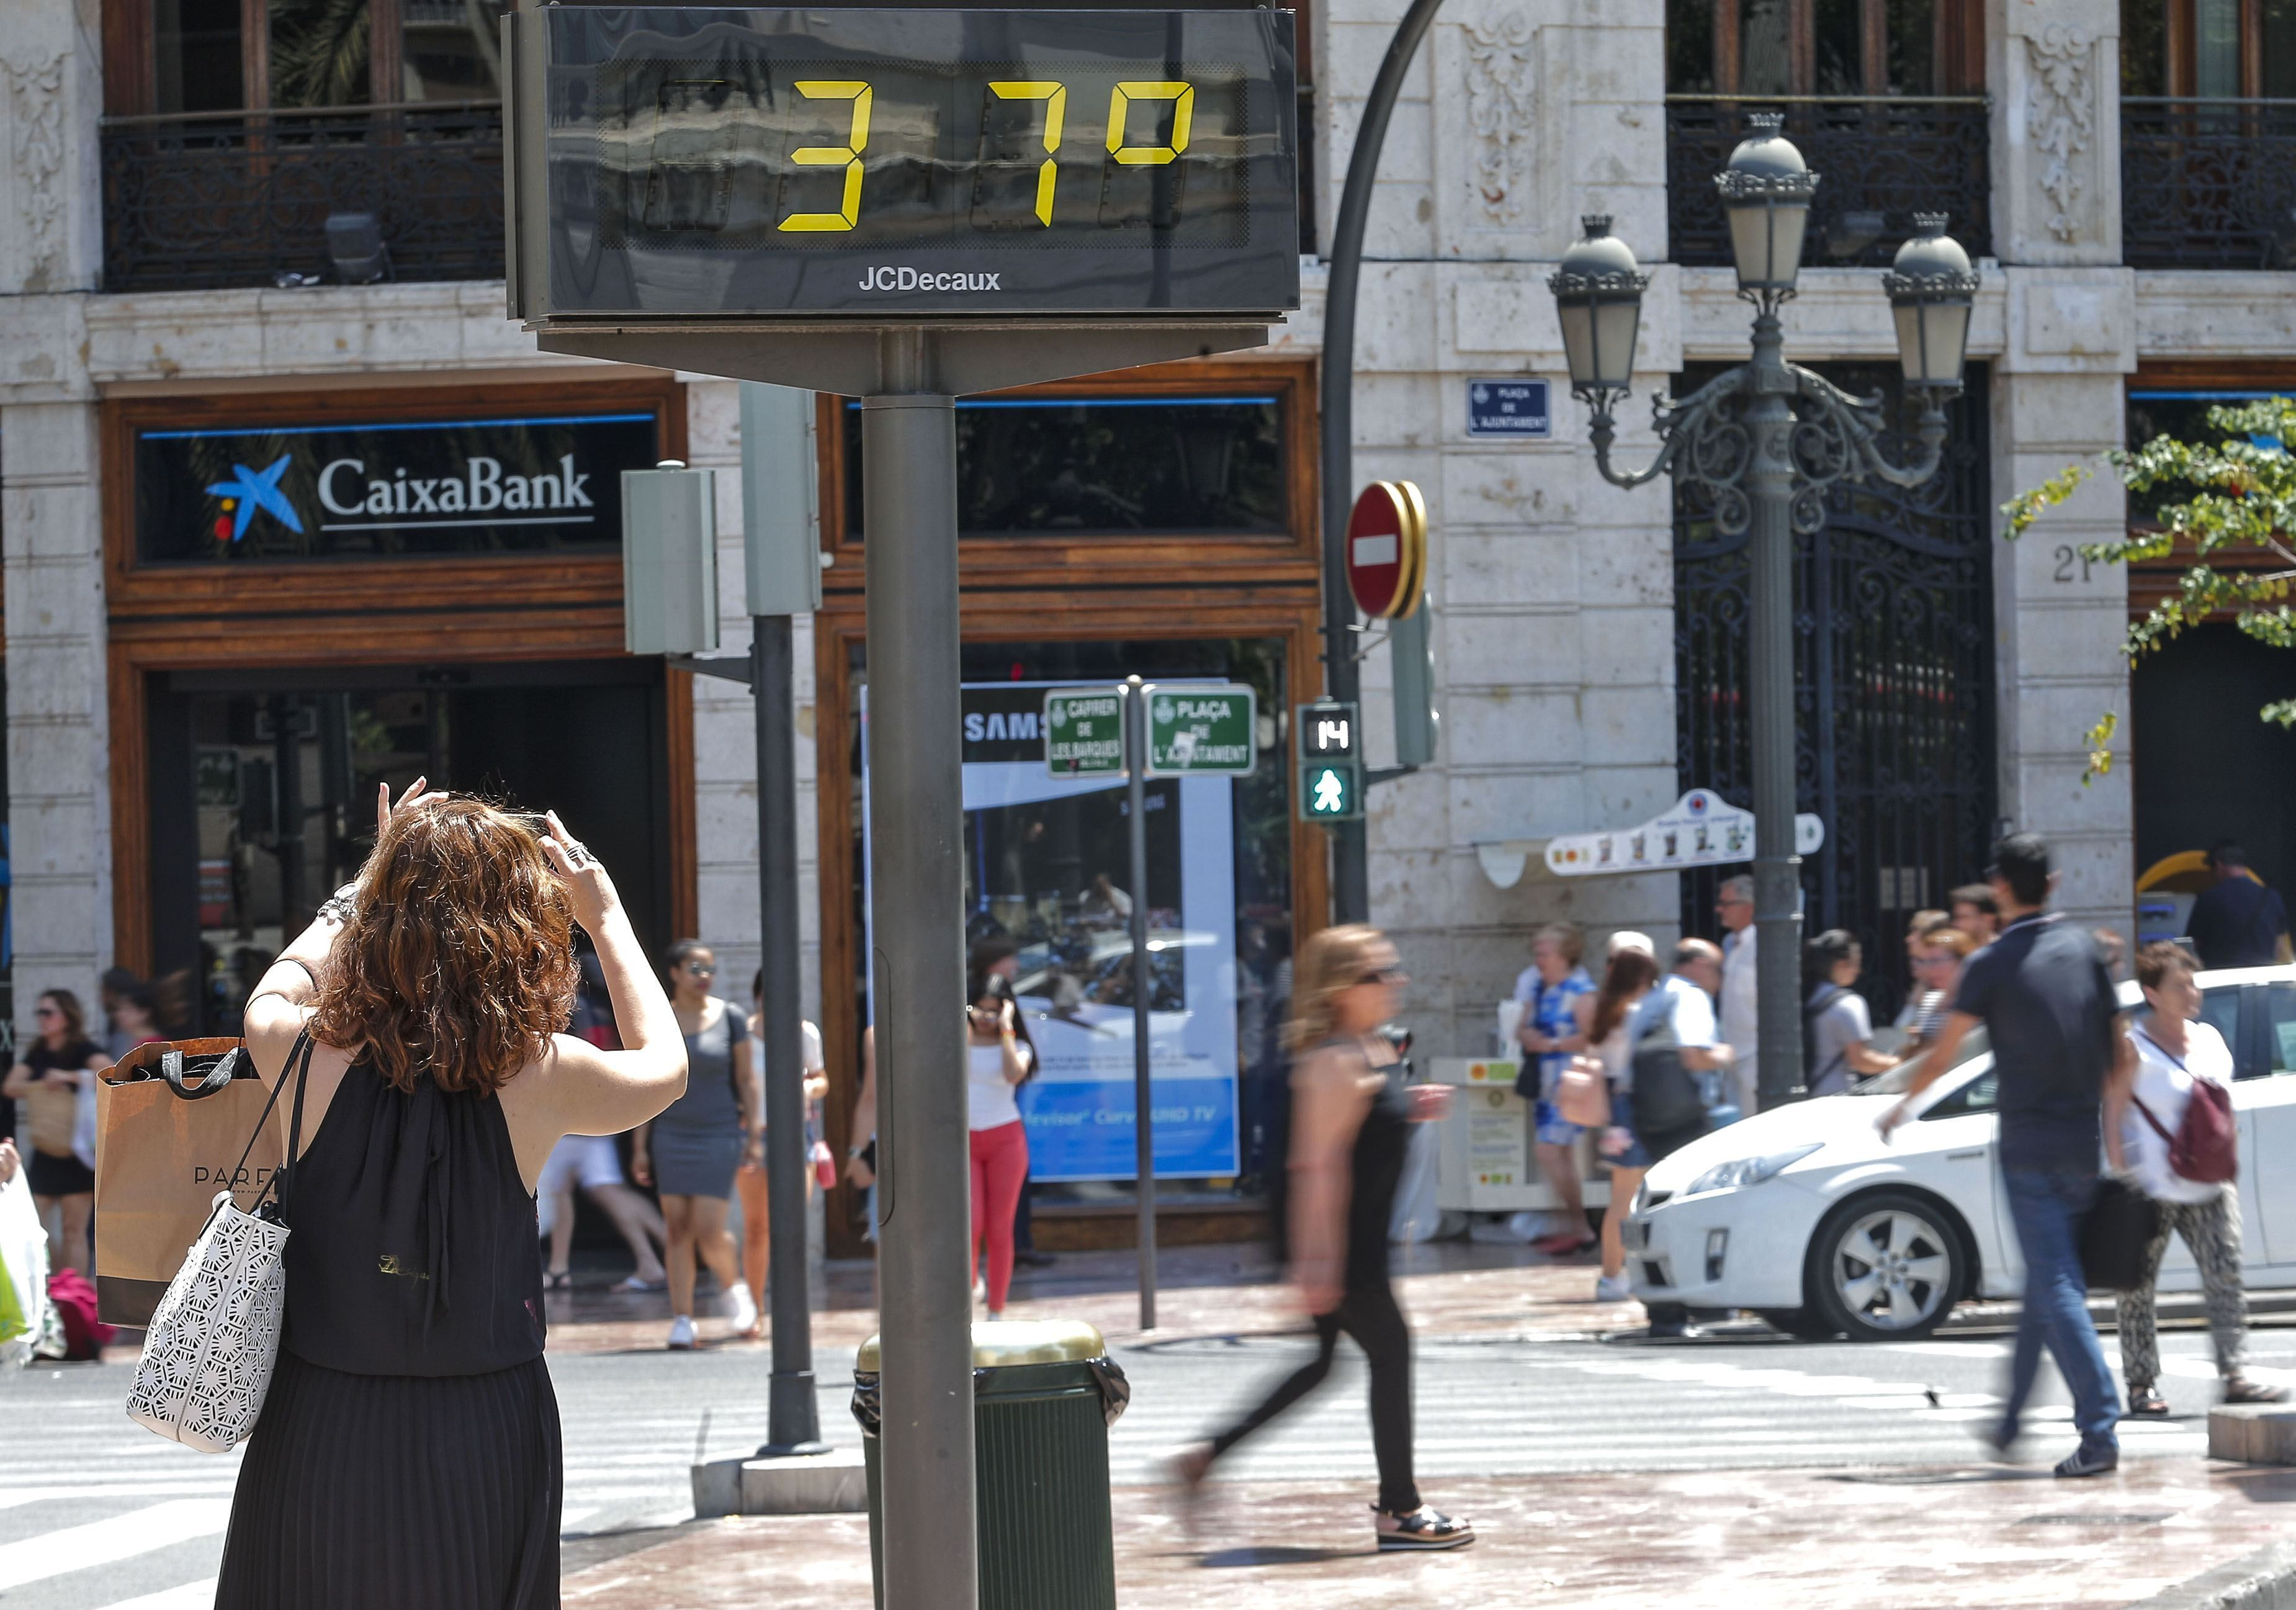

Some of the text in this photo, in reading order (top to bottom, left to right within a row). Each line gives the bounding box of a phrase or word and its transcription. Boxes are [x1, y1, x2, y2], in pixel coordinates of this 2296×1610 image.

[859, 266, 1001, 291] JCDecaux
[1501, 402, 1516, 413] DE
[318, 453, 594, 516] CaixaBank
[2054, 544, 2091, 583] 21
[1067, 699, 1117, 717] CARRER
[1177, 701, 1232, 723] PLAÇA
[1077, 721, 1093, 737] DE
[1190, 724, 1211, 740] DE
[1318, 720, 1348, 750] 14
[195, 1167, 272, 1185] PARF
